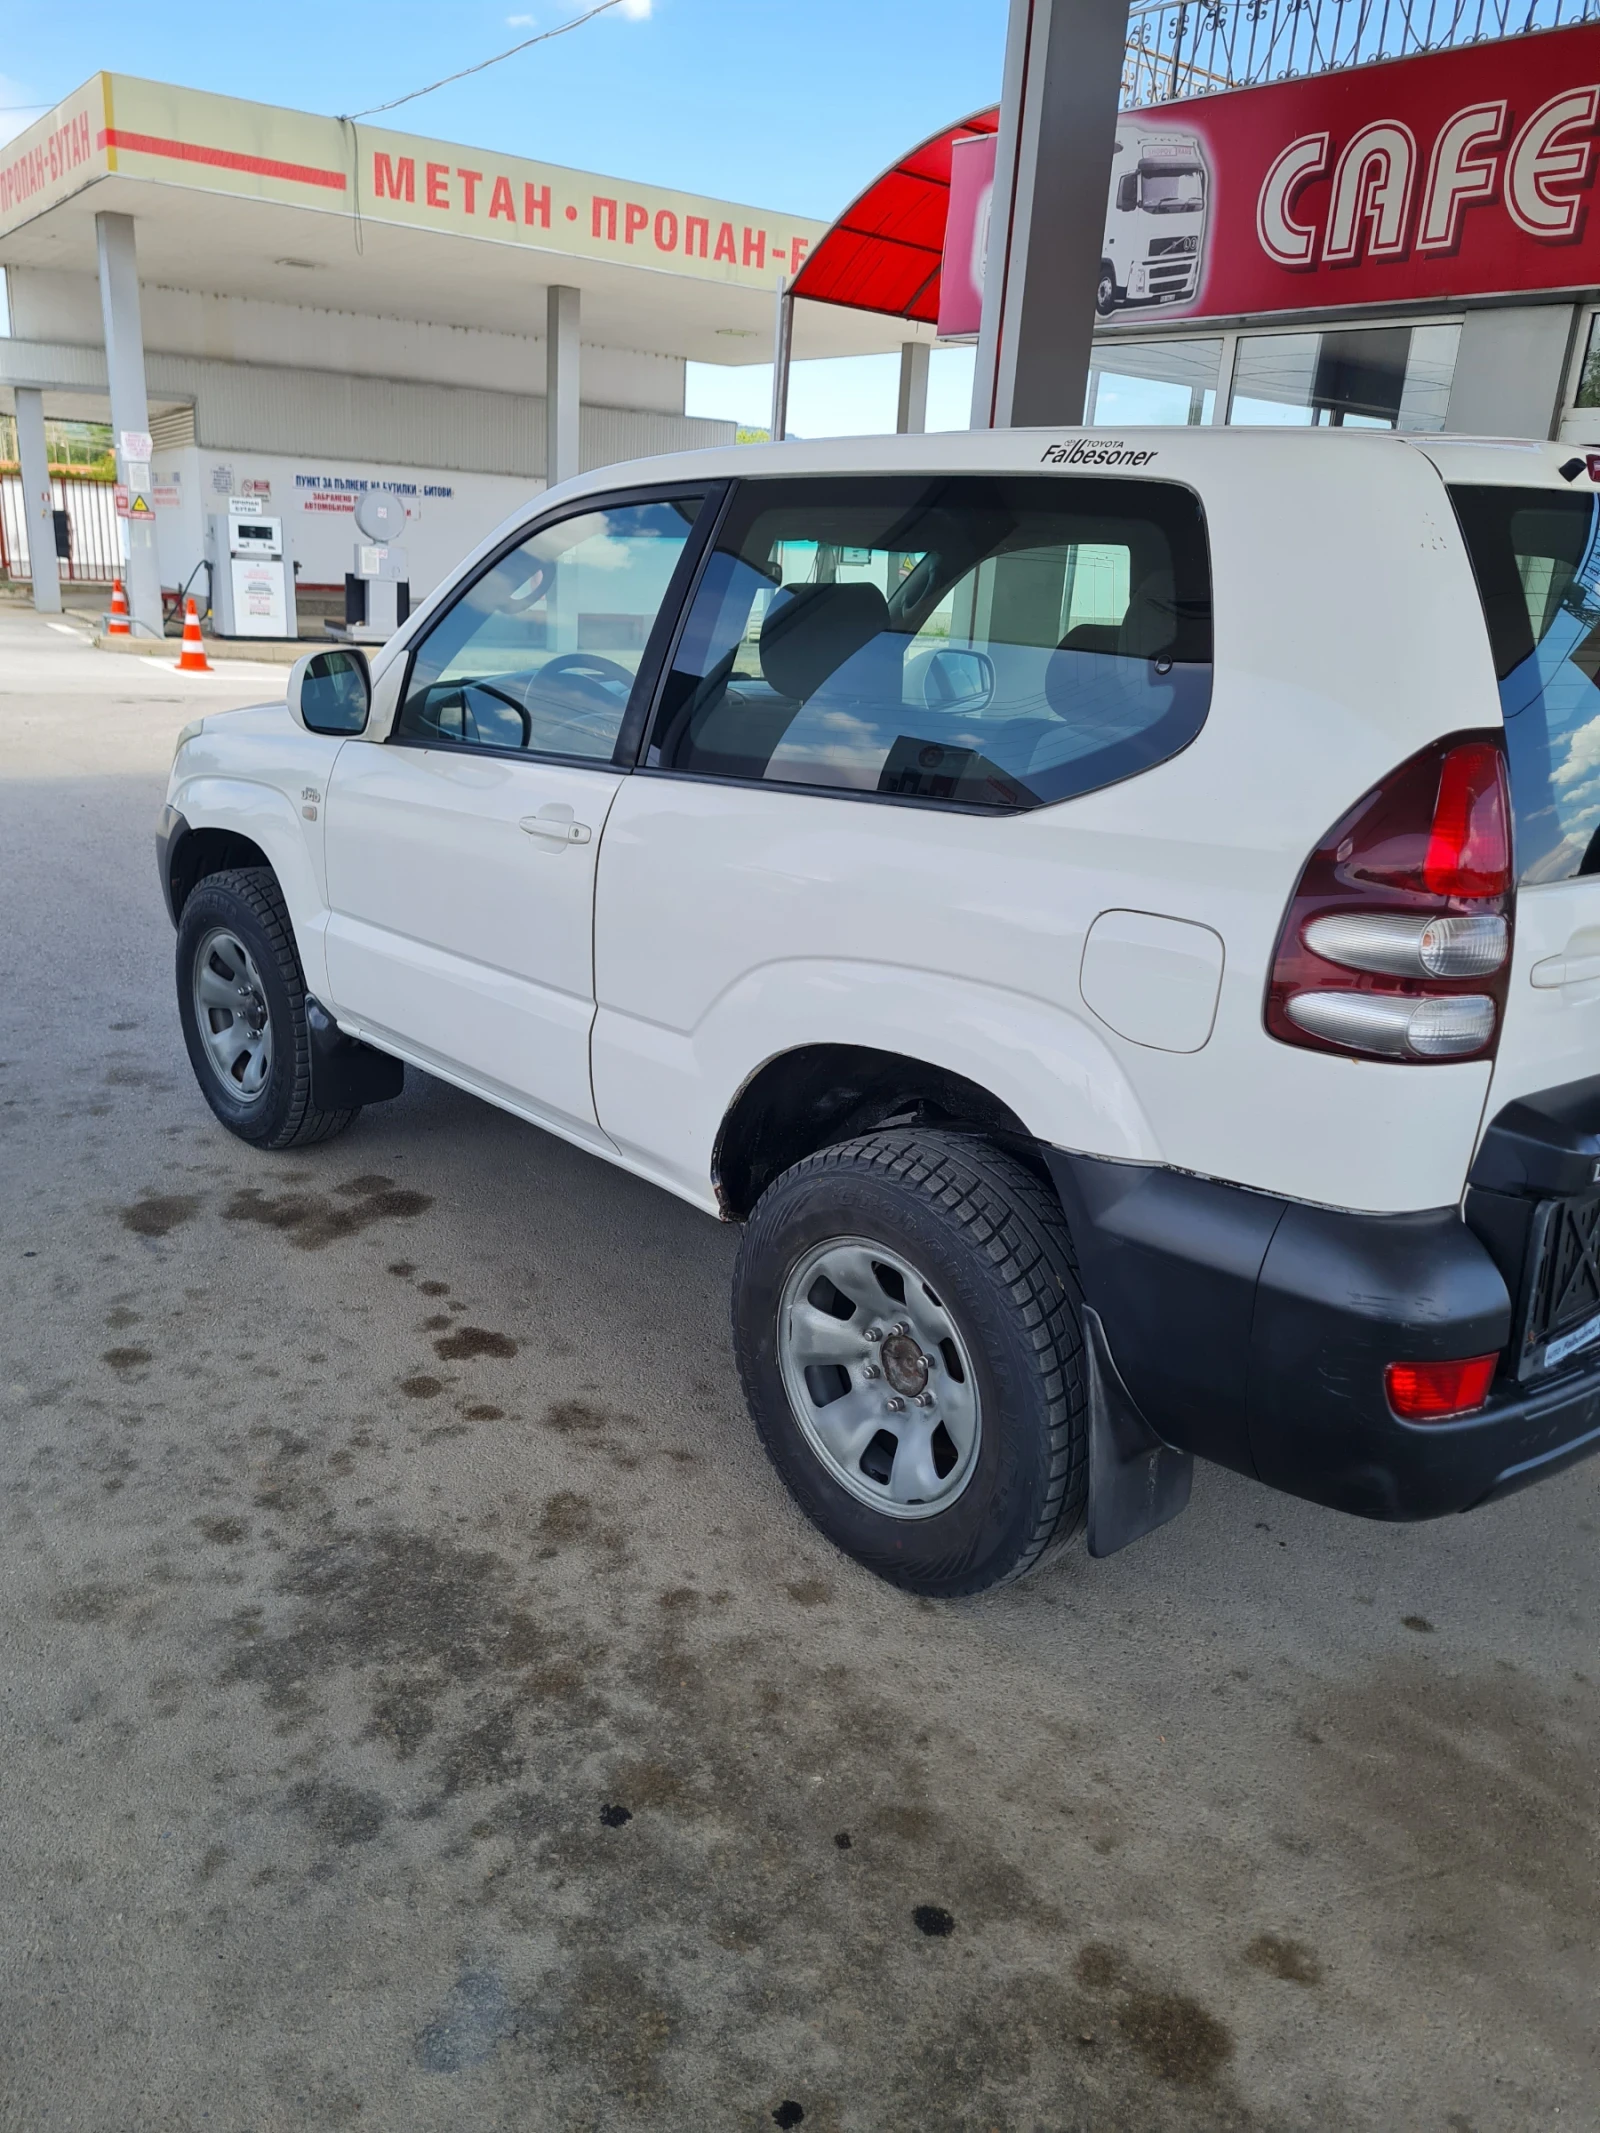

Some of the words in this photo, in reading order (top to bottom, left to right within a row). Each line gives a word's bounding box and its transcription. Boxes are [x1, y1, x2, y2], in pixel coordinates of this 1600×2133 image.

[0, 110, 91, 212] ПРОПАН-БУТАН
[1256, 84, 1600, 265] CAFE
[374, 152, 551, 229] МЕТАН
[1040, 438, 1159, 466] Falbesoner
[1086, 440, 1124, 448] TOYOTA
[295, 474, 321, 488] ПУНКТ
[322, 477, 332, 489] ЗА
[334, 478, 368, 491] ПЪЛНЕНЕ
[423, 485, 452, 498] БИТОВИ
